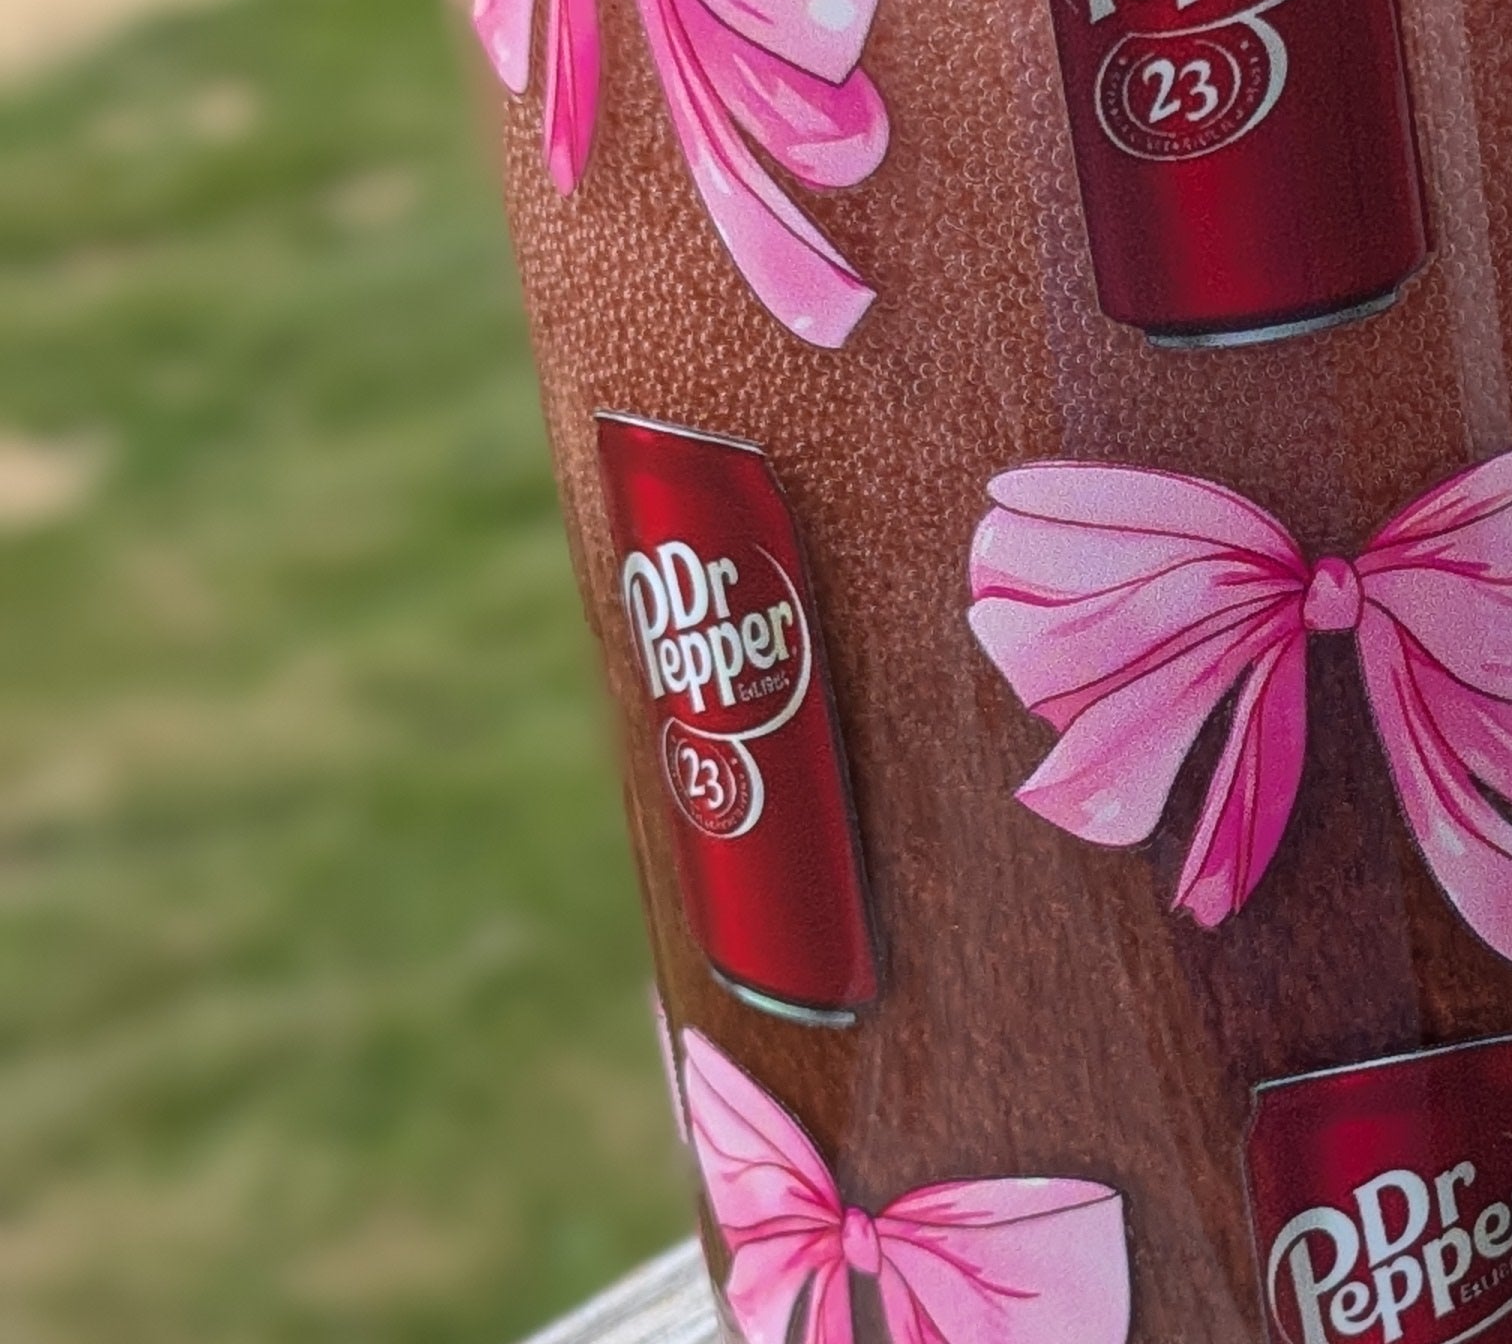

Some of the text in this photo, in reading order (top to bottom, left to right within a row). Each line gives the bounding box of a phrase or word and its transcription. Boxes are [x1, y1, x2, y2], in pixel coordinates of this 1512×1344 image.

[1142, 58, 1219, 124] 23
[656, 540, 739, 631] Dr
[623, 551, 793, 714] Pepper
[679, 747, 725, 809] 23
[1353, 1160, 1476, 1269] Dr
